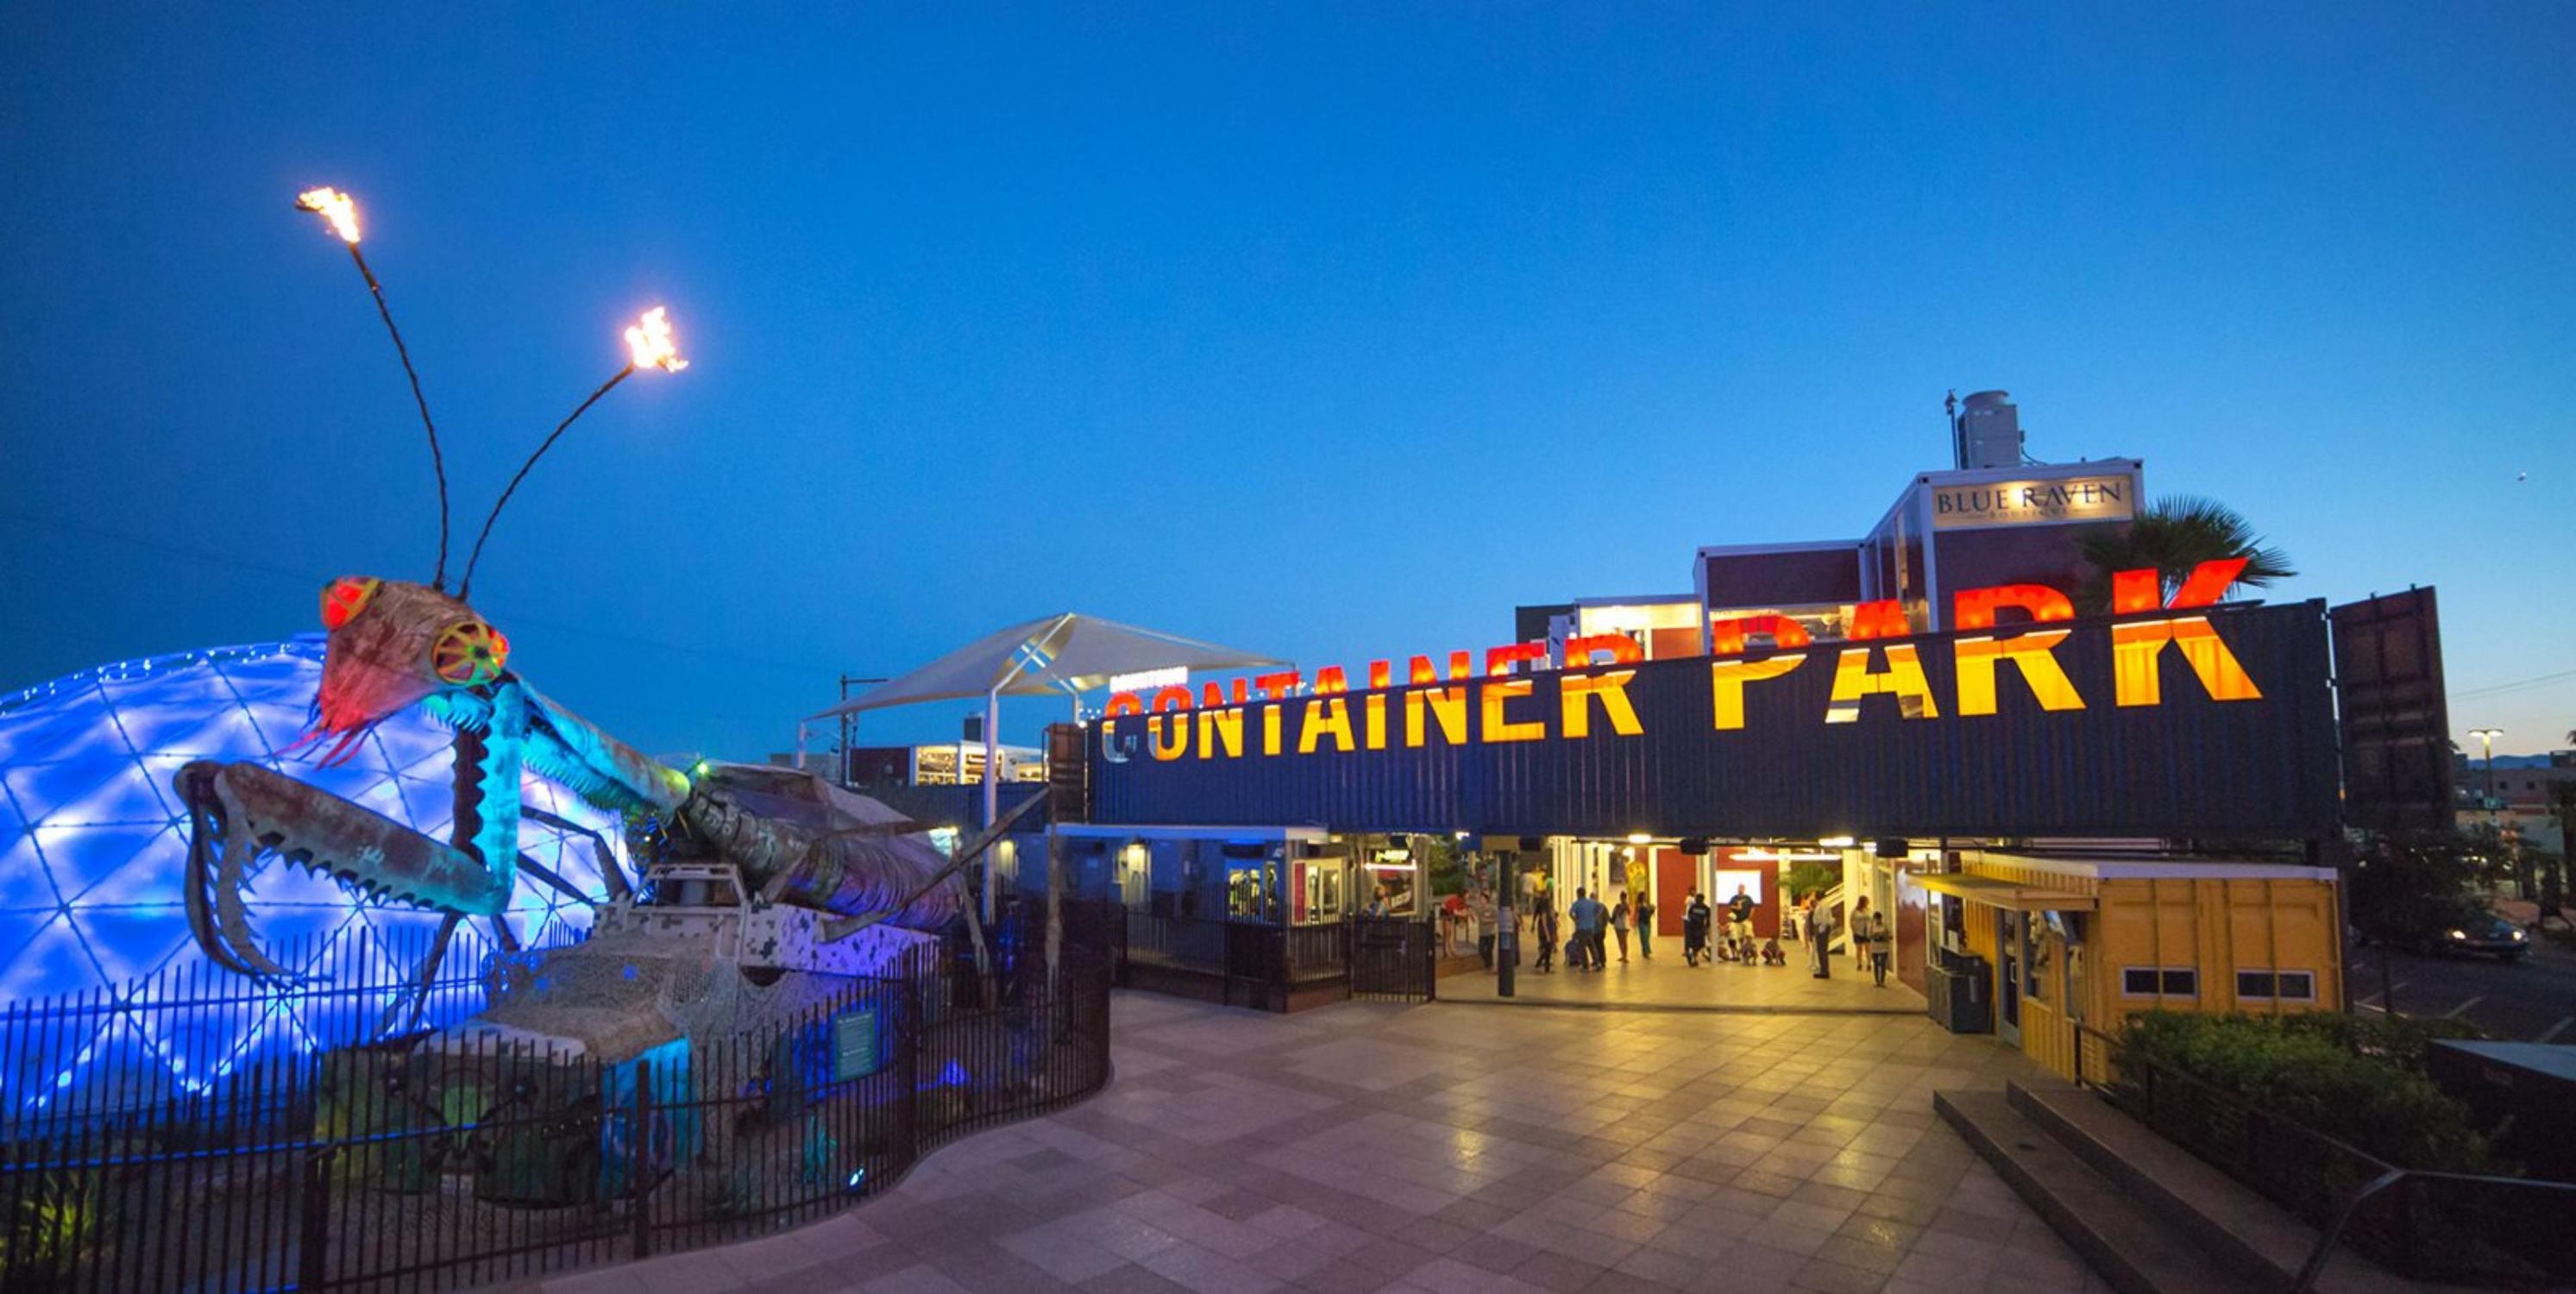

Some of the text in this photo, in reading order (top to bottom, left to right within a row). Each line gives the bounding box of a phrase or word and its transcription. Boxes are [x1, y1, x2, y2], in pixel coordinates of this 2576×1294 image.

[1938, 482, 2121, 514] BLUE RAVEN
[1102, 557, 2263, 763] CONTAINER PARK
